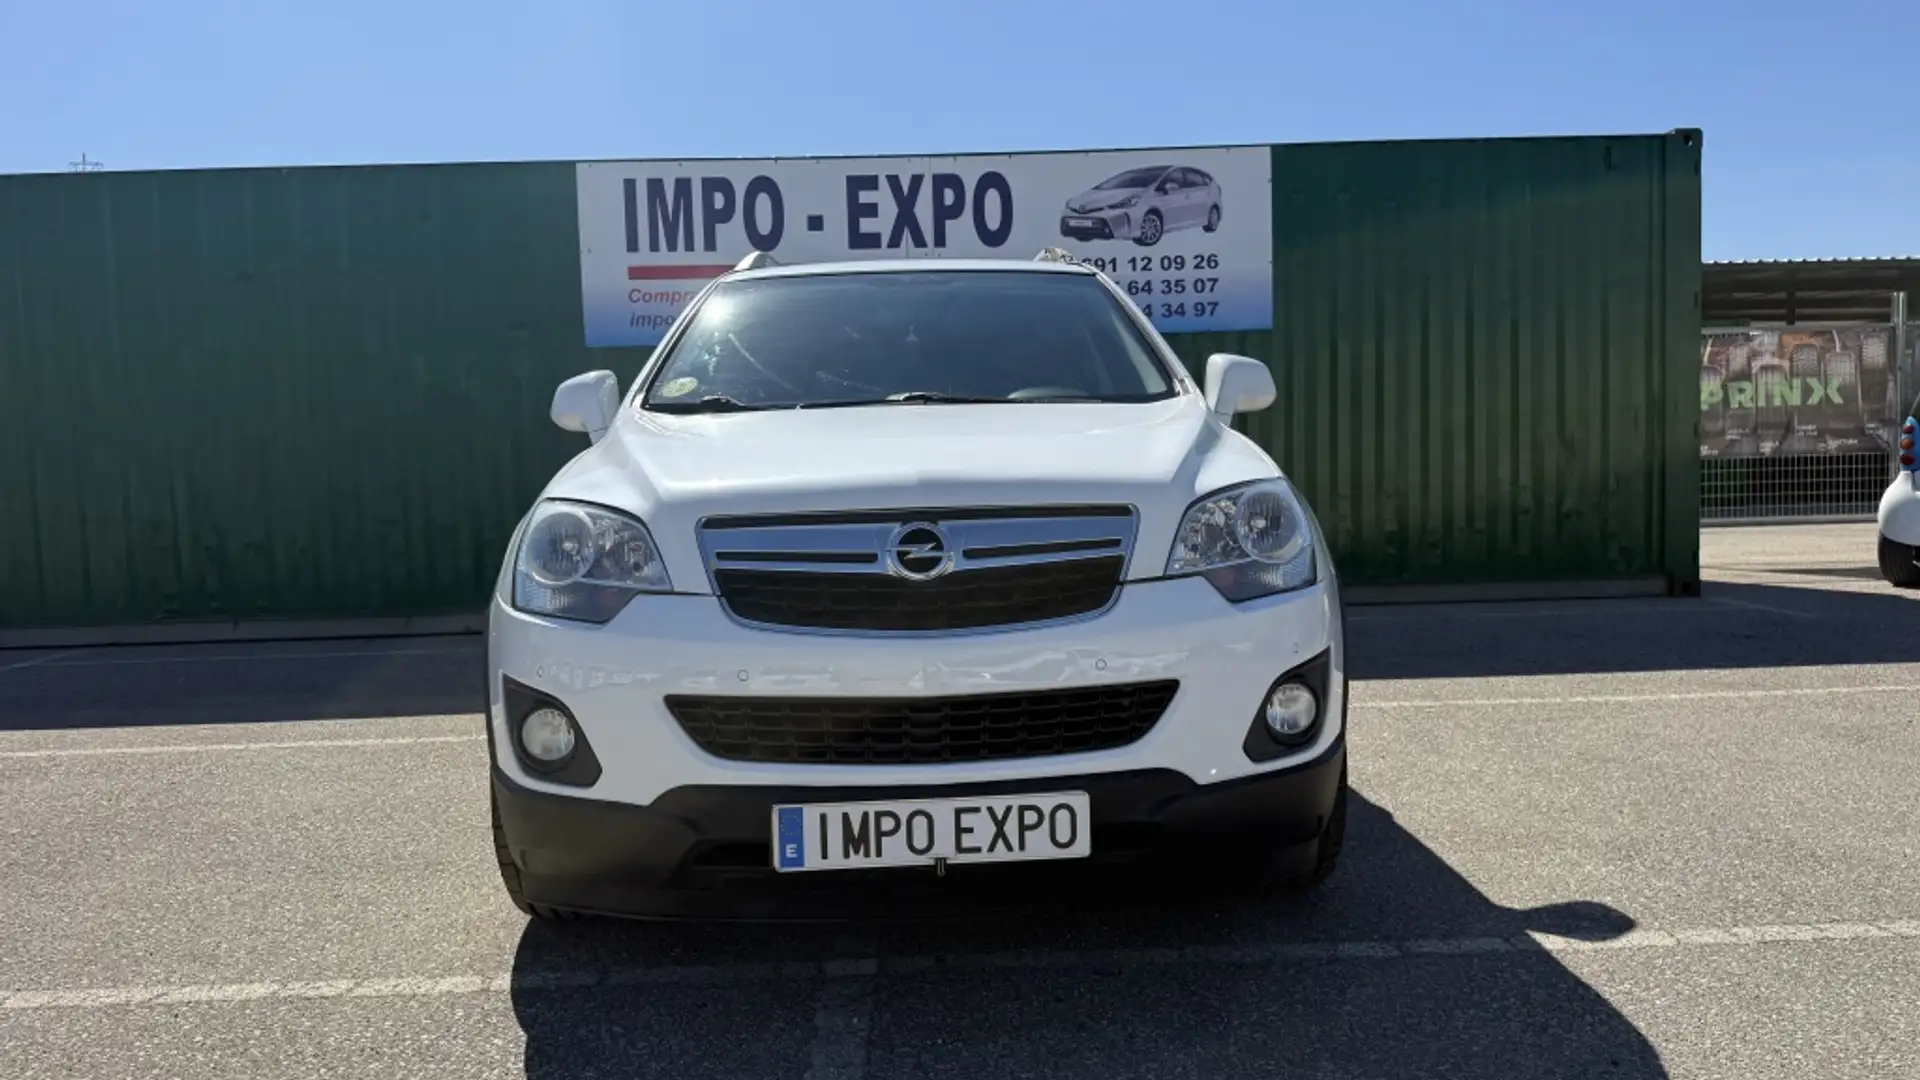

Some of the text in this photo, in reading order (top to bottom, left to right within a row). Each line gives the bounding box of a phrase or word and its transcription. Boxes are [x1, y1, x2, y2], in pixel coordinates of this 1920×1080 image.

[623, 175, 784, 253] IMPO
[846, 171, 1013, 249] EXPO
[1127, 256, 1152, 272] 12
[1160, 255, 1186, 271] 09
[1193, 253, 1219, 270] 26
[1127, 278, 1219, 296] 64 35 07
[1161, 302, 1186, 318] 34
[1193, 301, 1219, 317] 97
[1700, 375, 1844, 411] PRINX
[820, 803, 1077, 859] IMPO EXPO
[785, 844, 797, 858] E
